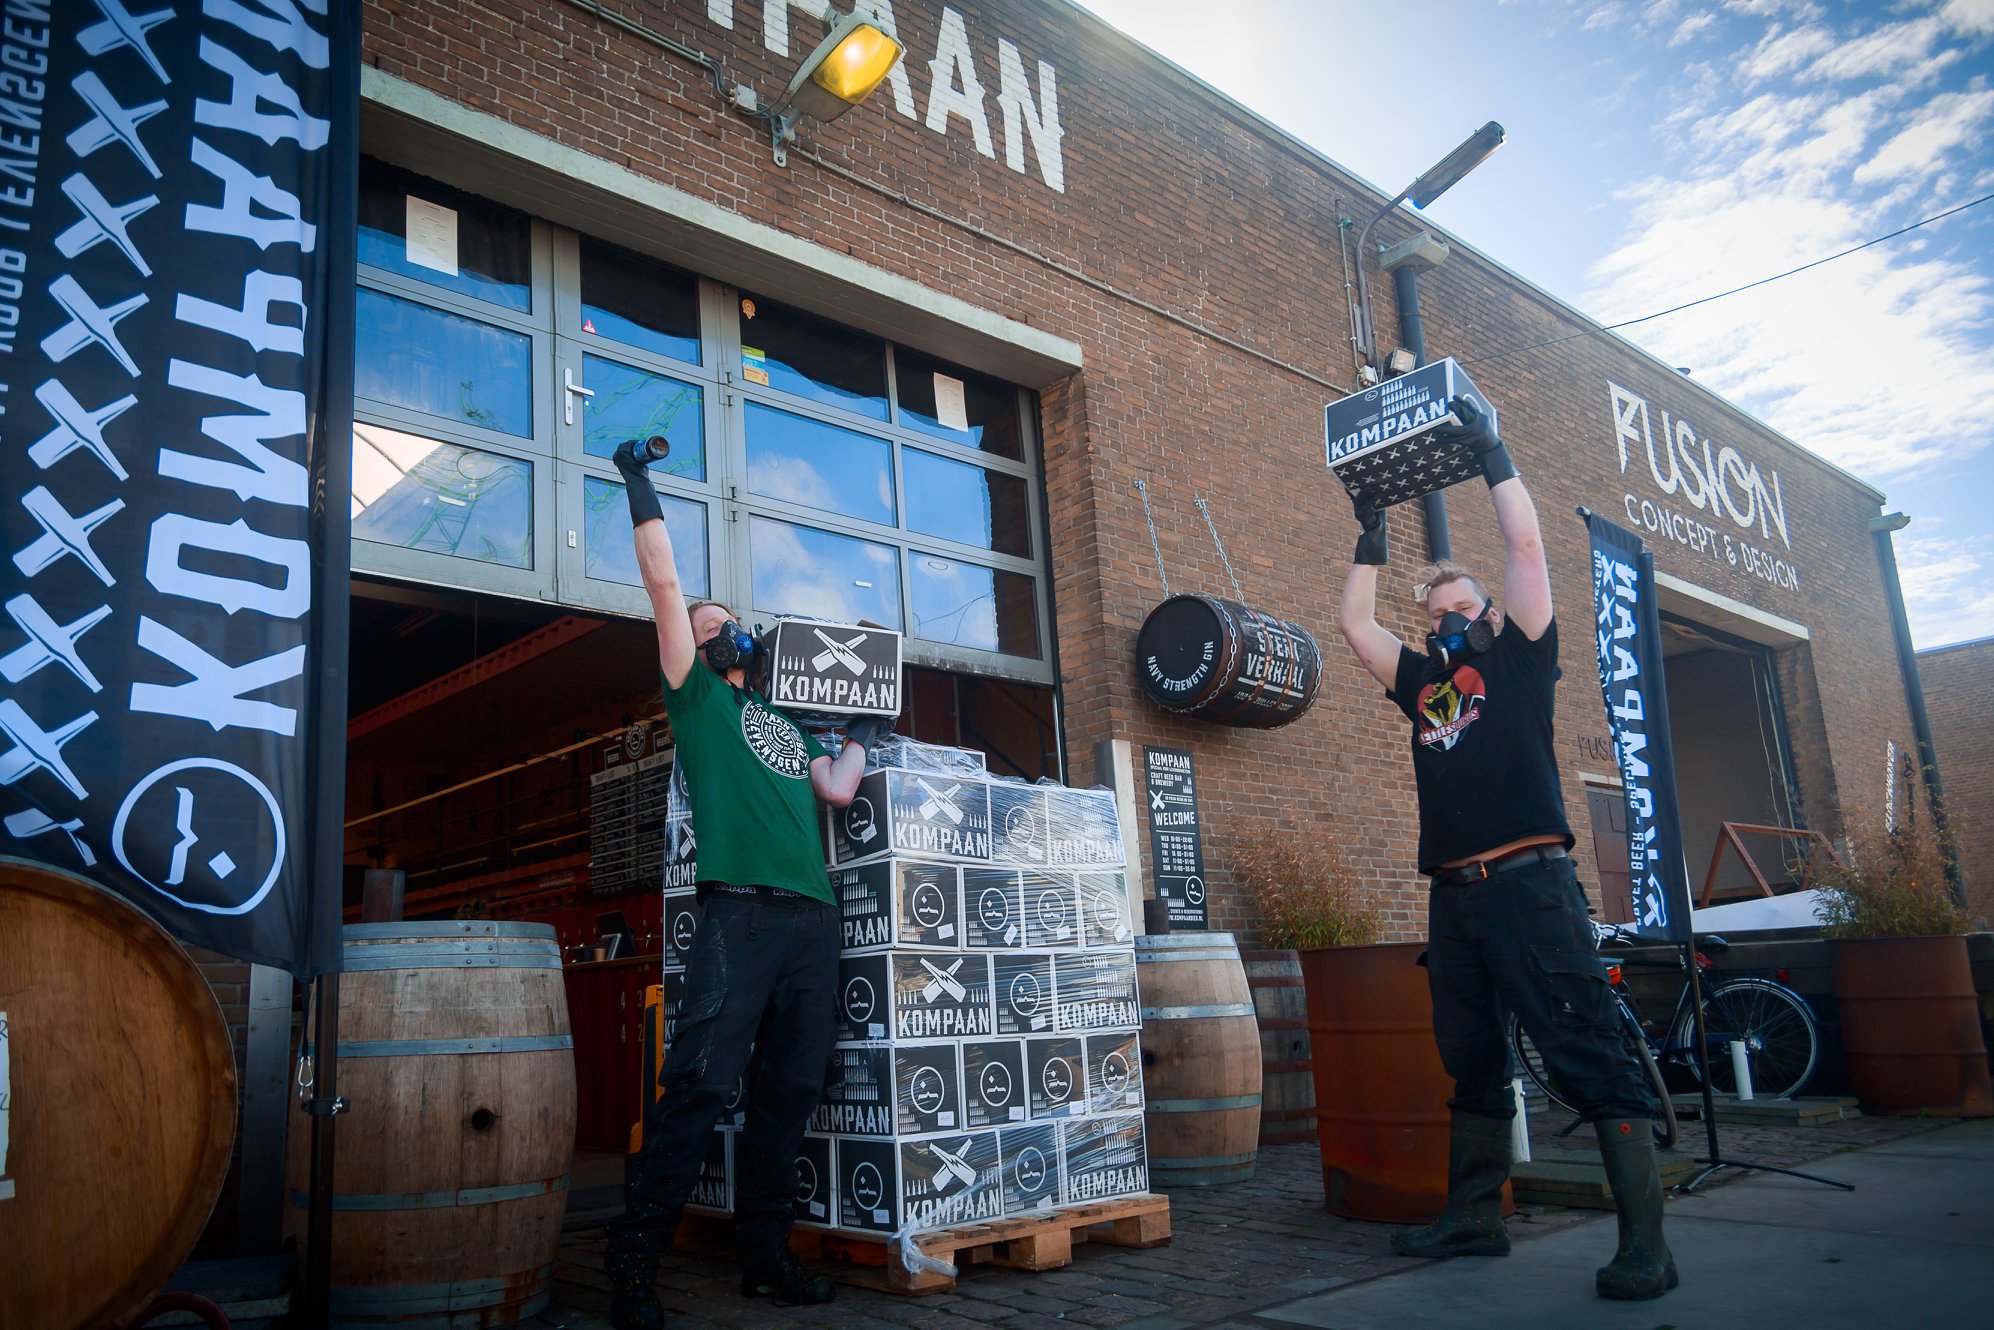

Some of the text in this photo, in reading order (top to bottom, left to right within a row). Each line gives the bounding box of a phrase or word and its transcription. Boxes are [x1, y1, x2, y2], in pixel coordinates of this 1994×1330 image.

[1331, 398, 1446, 461] KOMPAAN
[1607, 380, 1791, 551] FUSION
[1624, 494, 1799, 592] CONCEPT & DESIGN
[1147, 641, 1214, 692] NAVY STRENGTH GIN
[779, 674, 895, 709] KOMPAAN
[1149, 751, 1190, 769] KOMPAAN
[1577, 734, 1616, 763] FUSI
[1154, 811, 1195, 826] WELCOME
[896, 821, 988, 858] KOMPAAN
[665, 862, 697, 887] KOMP
[840, 916, 889, 947] PAAN
[898, 1008, 990, 1037] KOMPAAN
[1058, 1001, 1138, 1028] KOMPAAN
[809, 1105, 889, 1134] KOMPAAN
[1069, 1164, 1145, 1201] KOMPAAN
[906, 1189, 1000, 1228] KOMPAAN
